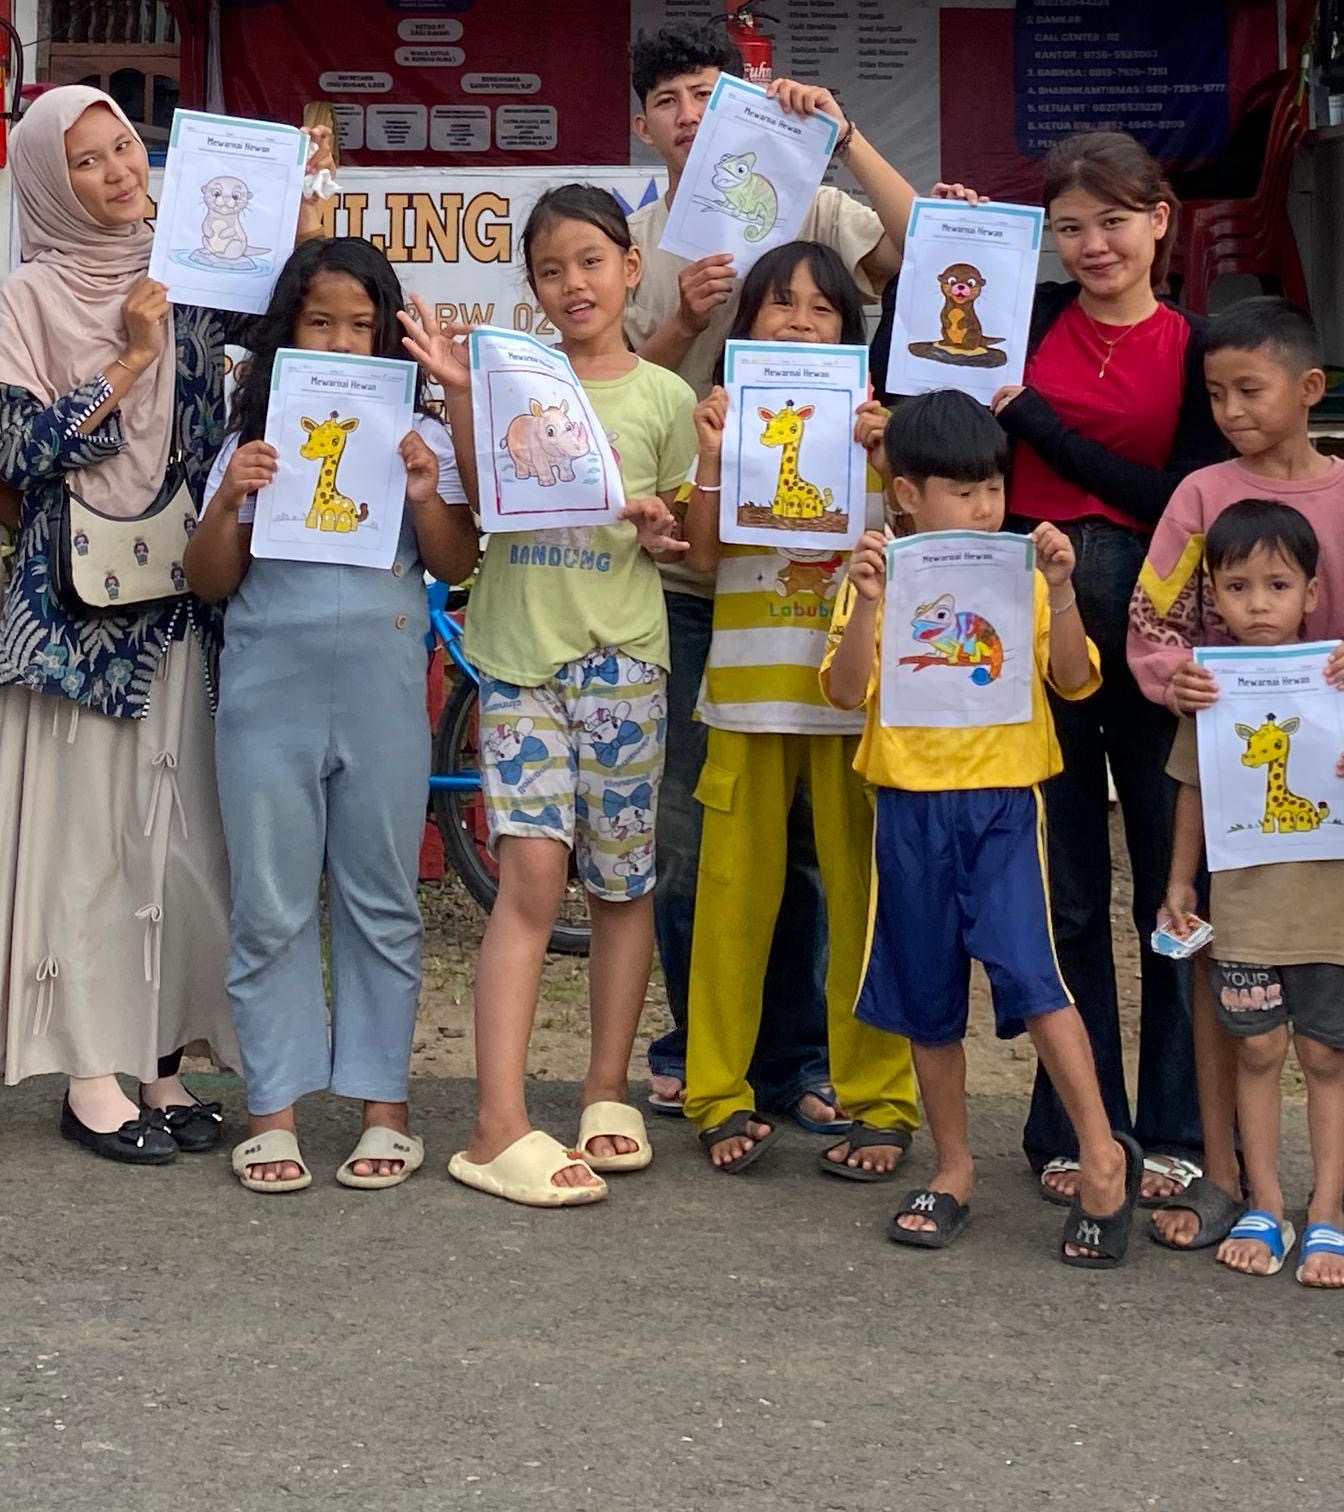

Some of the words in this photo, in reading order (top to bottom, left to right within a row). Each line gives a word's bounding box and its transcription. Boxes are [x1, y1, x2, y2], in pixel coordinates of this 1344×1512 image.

[1034, 33, 1058, 41] CALL
[1038, 104, 1071, 113] KETUA
[743, 106, 777, 126] Mewarnai
[779, 118, 802, 136] Hewan
[1038, 122, 1072, 130] KETUA
[207, 136, 243, 148] Mewarnai
[244, 143, 270, 153] Hewan
[941, 223, 976, 235] Mewarnai
[978, 226, 1004, 238] Hewan
[764, 367, 801, 378] Mewarnai
[803, 368, 830, 379] Hewan
[310, 376, 349, 389] Mewarnai
[350, 380, 377, 391] Hewan
[922, 552, 962, 564] Mewarnai
[964, 551, 993, 561] Hewan
[769, 600, 834, 618] Labub
[1238, 676, 1280, 688] Mewarnai
[1281, 675, 1310, 686] Hewan
[1223, 972, 1271, 986] YOUR
